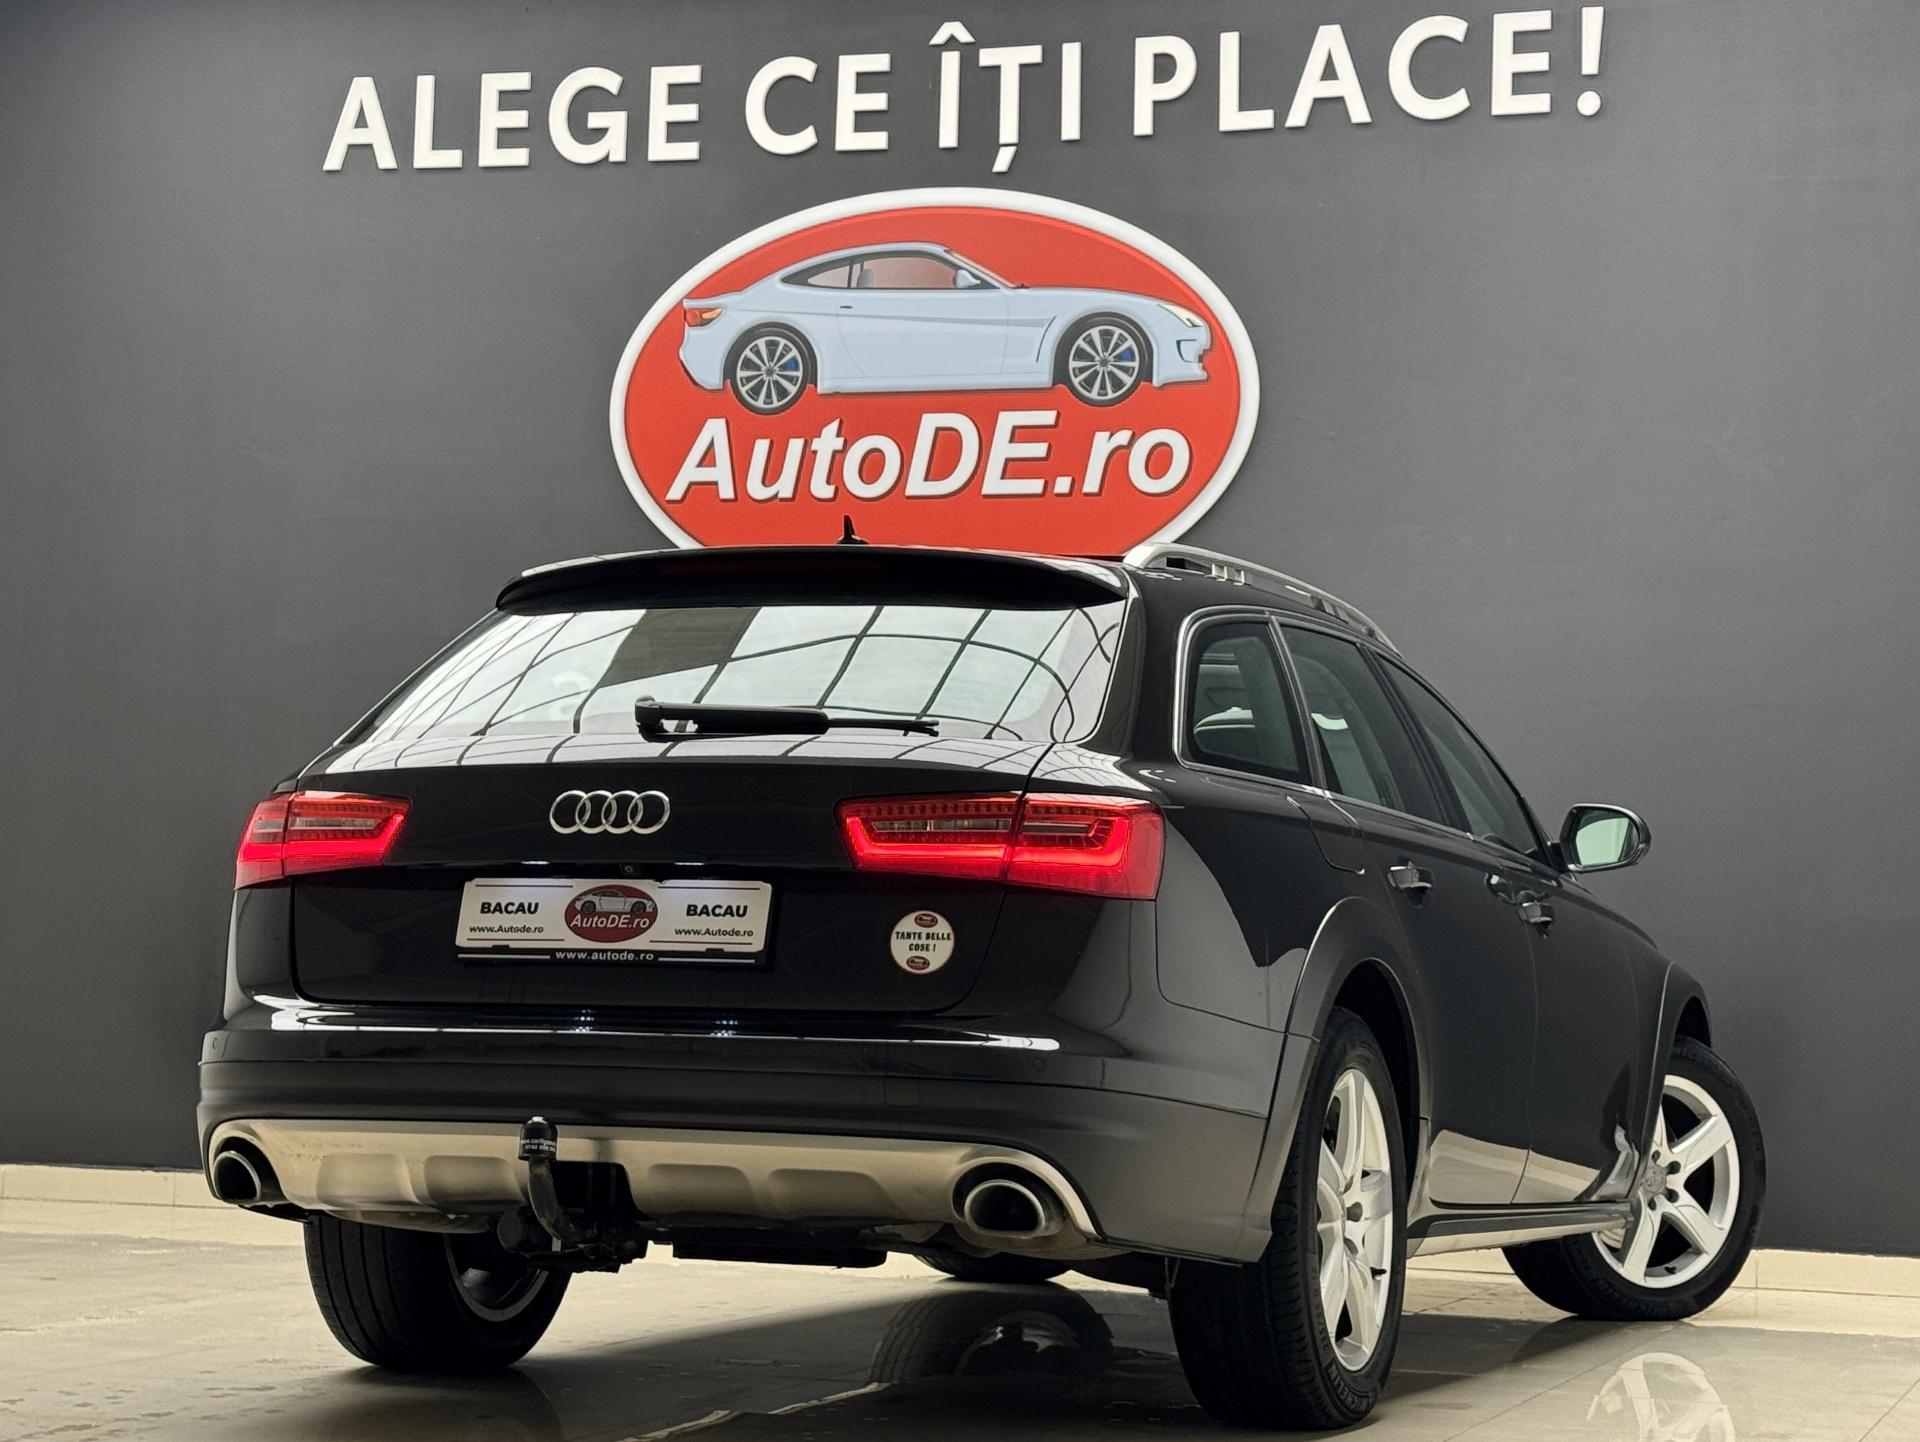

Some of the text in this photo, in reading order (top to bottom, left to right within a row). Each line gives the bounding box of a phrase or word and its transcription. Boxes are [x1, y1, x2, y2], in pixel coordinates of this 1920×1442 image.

[323, 65, 701, 170] ALEGE
[746, 54, 890, 154] CE
[1134, 7, 1603, 135] PLACE!
[667, 411, 1189, 499] AutoDE.ro
[480, 902, 539, 914] BACAU
[686, 905, 748, 917] BACAU
[570, 914, 650, 928] AutoDE.ro
[469, 925, 544, 933] www.Autode.ro
[675, 928, 753, 937] www.Autode.ro
[895, 931, 952, 941] TANTE BELLE
[909, 943, 930, 952] COSE
[555, 951, 654, 961] www.autode.ro
